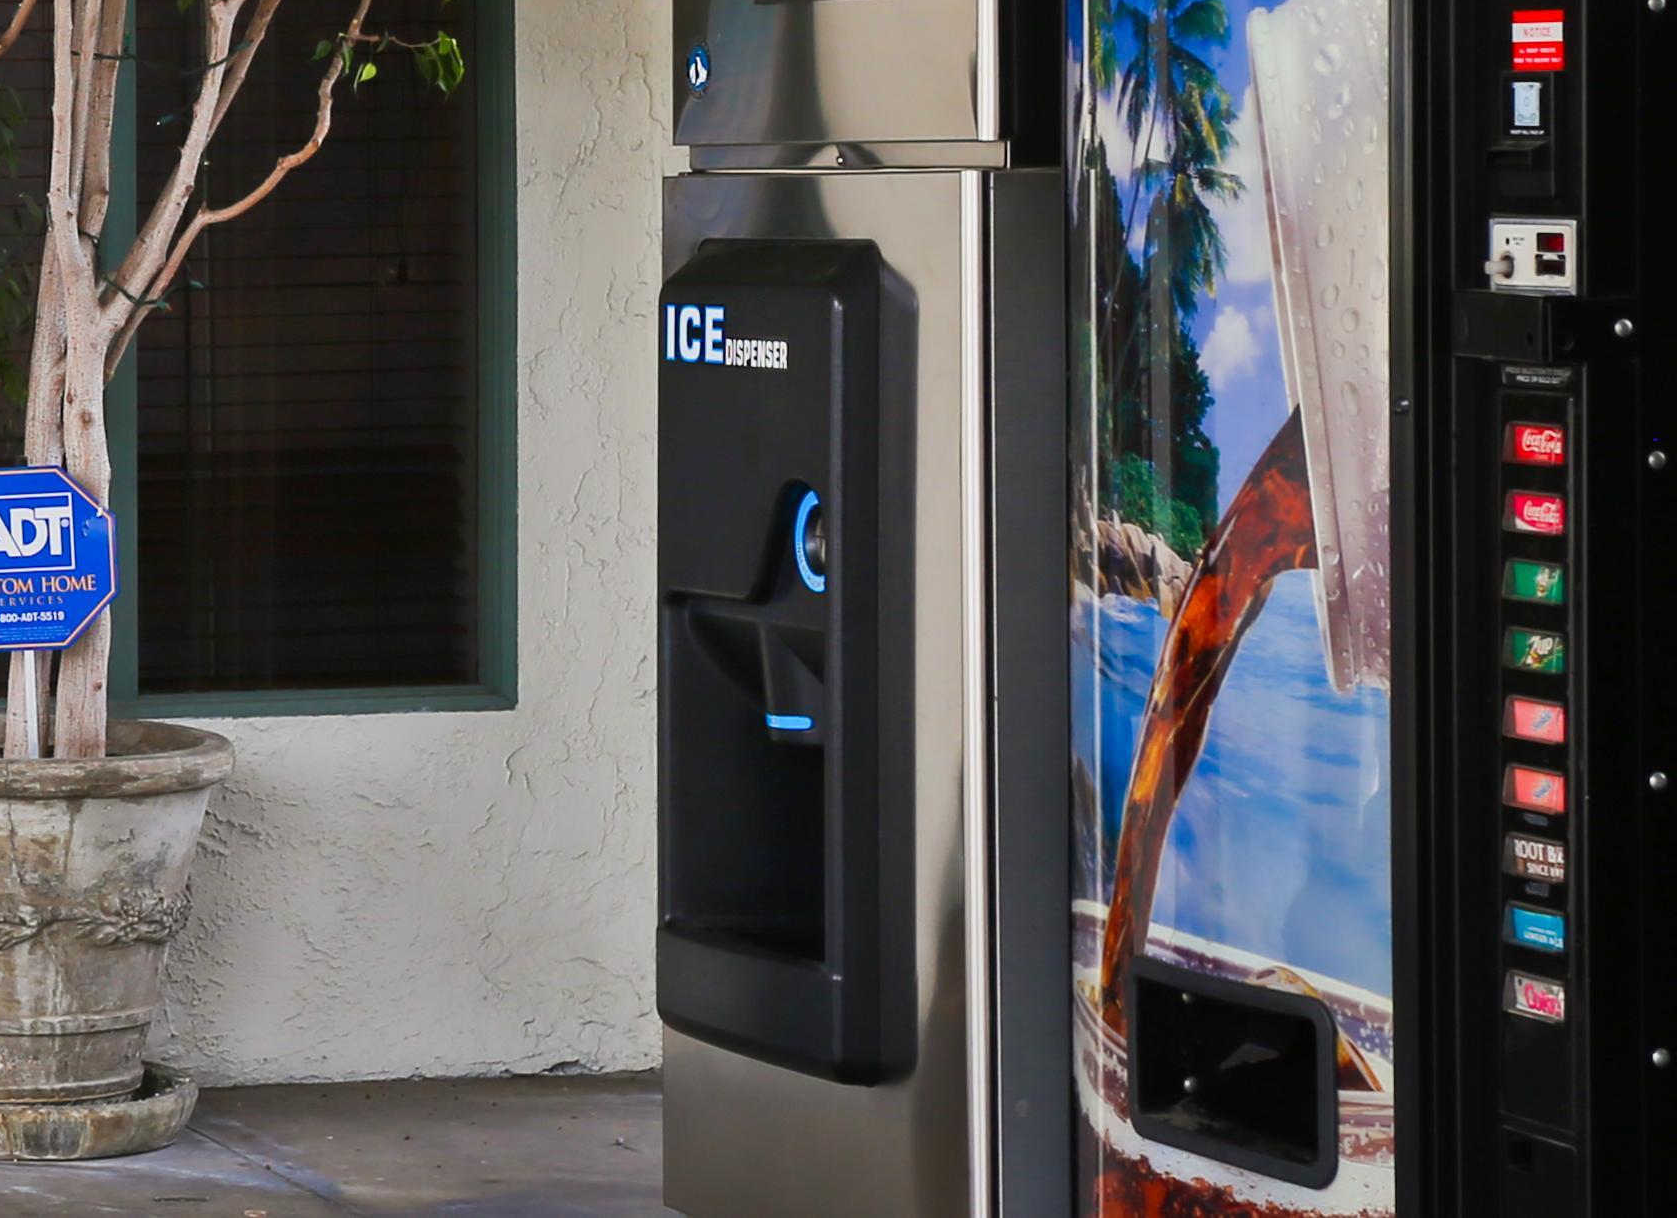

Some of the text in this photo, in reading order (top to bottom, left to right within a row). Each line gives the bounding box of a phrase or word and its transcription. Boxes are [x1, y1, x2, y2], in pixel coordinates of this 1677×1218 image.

[666, 304, 788, 370] ICE DISPENSER
[41, 574, 97, 593] HOME
